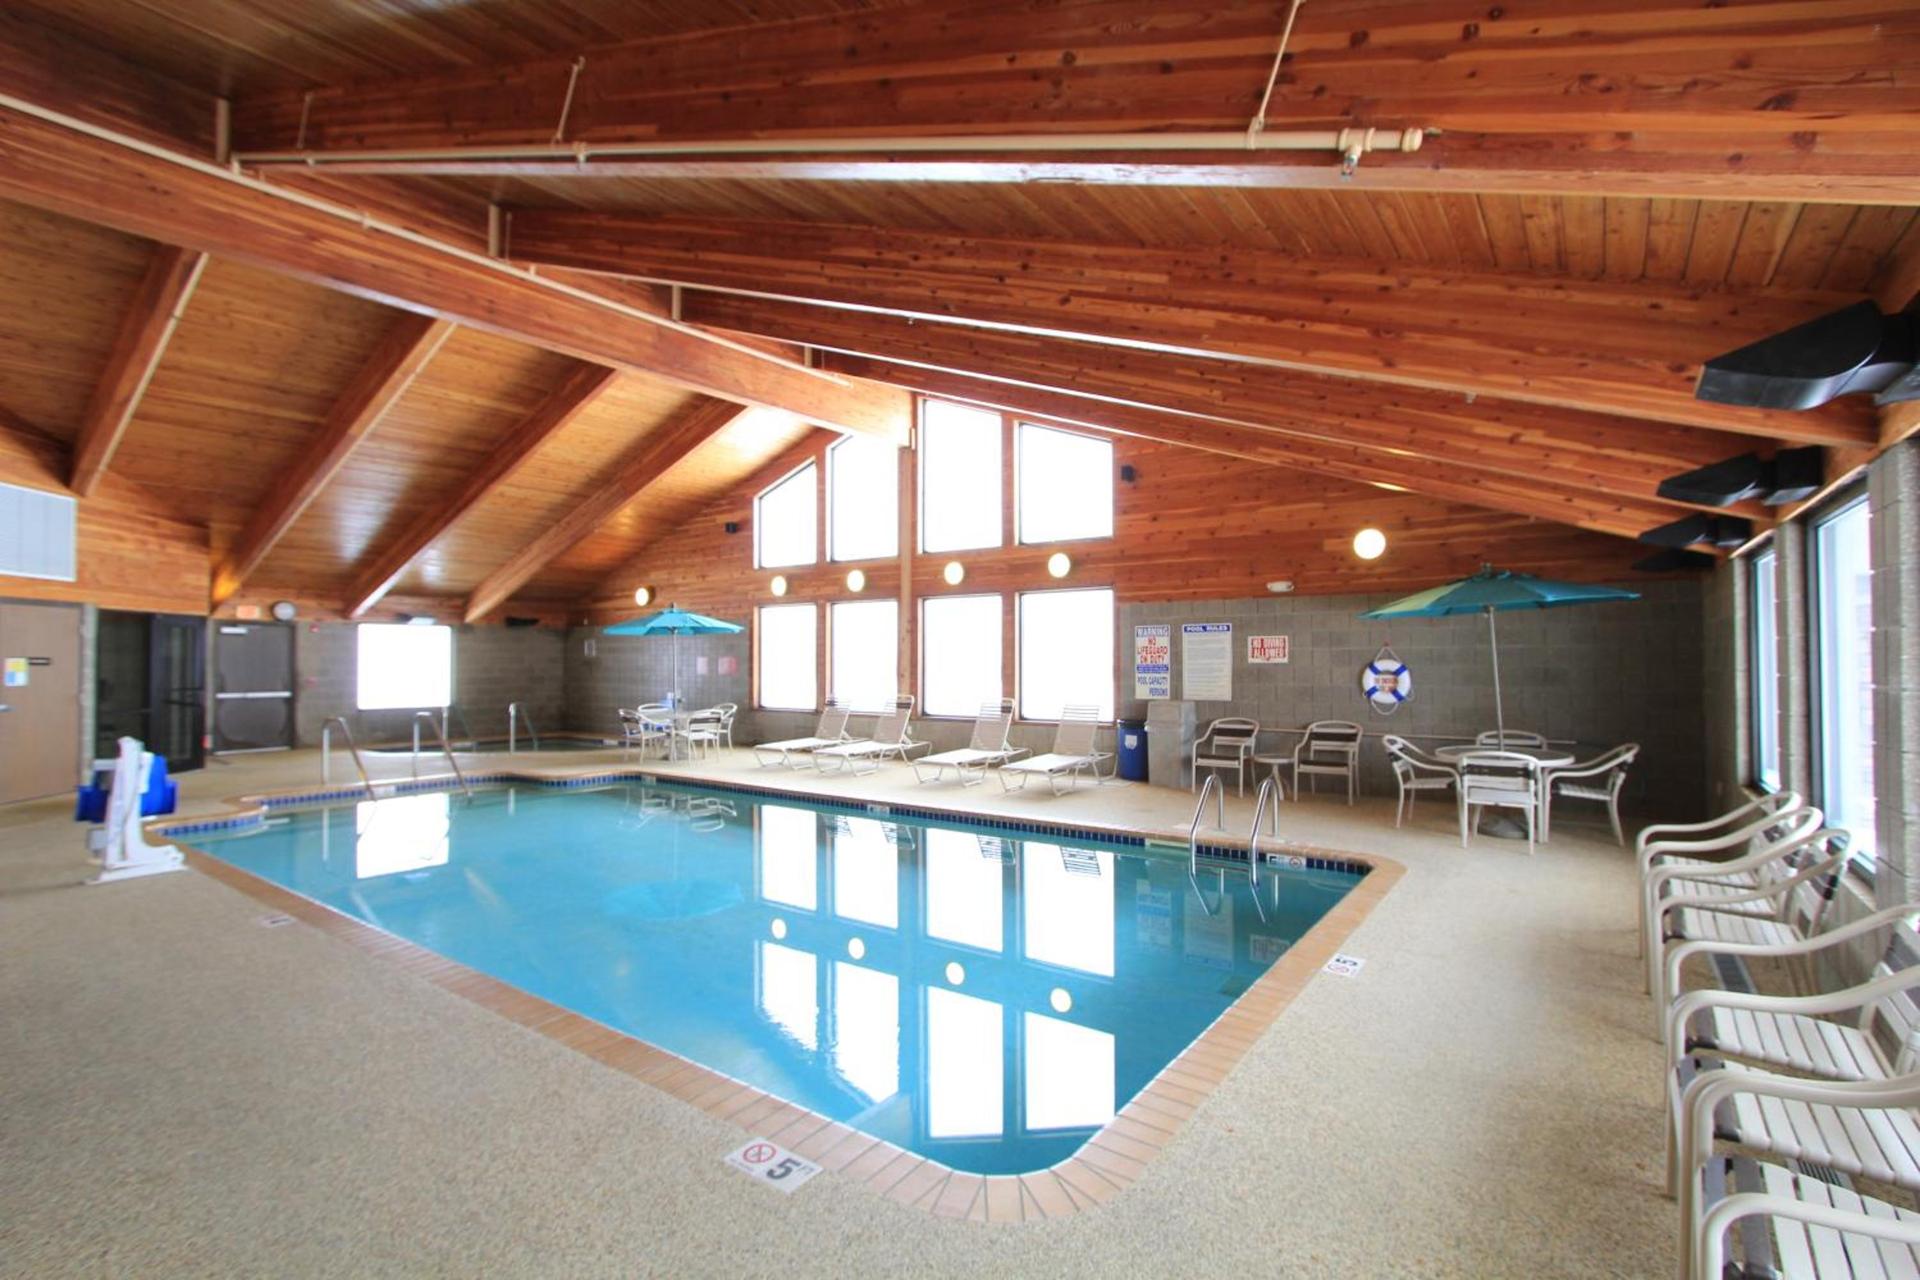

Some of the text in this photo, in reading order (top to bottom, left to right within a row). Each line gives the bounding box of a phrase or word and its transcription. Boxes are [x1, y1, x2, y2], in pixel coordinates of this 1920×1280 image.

[1137, 628, 1168, 637] WARNING
[1148, 637, 1156, 646] NO
[1137, 646, 1168, 655] LIFEGUARD
[1140, 655, 1165, 664] ON DUTY
[766, 1158, 801, 1180] 5
